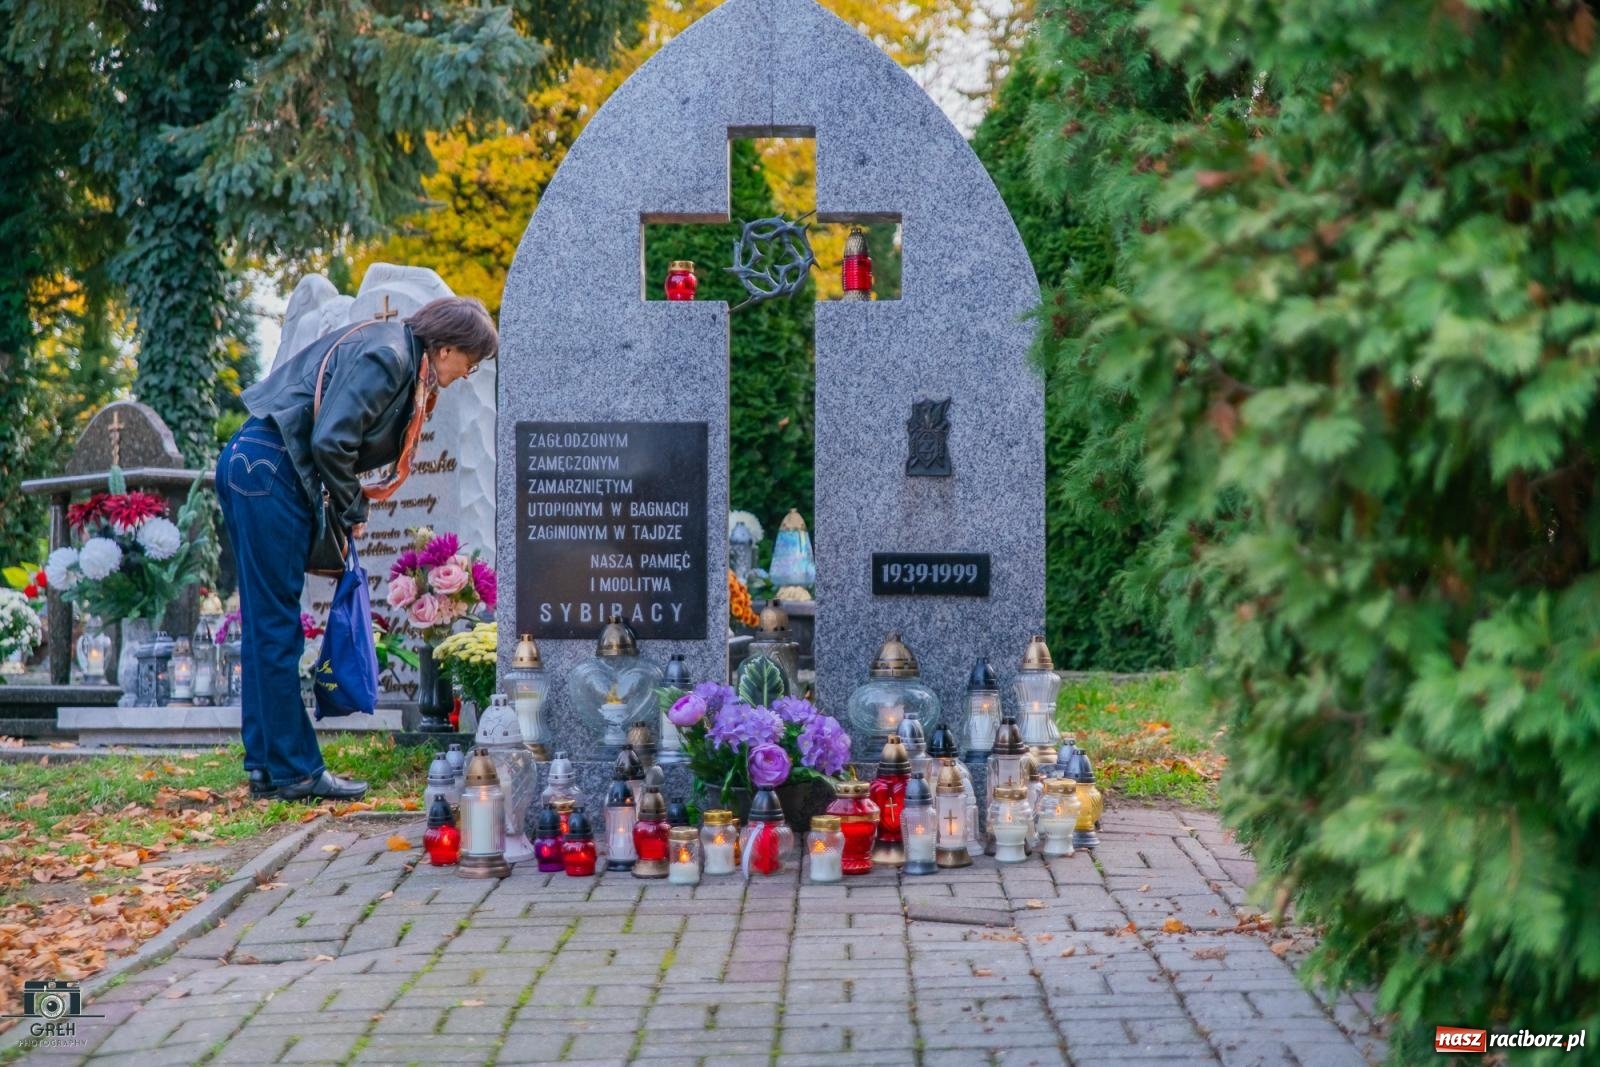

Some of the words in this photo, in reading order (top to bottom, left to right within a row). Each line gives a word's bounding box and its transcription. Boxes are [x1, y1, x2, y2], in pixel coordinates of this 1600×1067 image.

[528, 432, 628, 448] ZAGŁODZONYM
[528, 455, 620, 473] ZAMĘCZONYM
[528, 479, 633, 496] ZAMARZNIĘTYM
[528, 502, 603, 517] UTOPIONYM
[611, 502, 622, 516] W
[630, 502, 689, 517] BAGNACH
[528, 525, 608, 540] ZAGINIONYM
[613, 525, 625, 540] W
[632, 525, 683, 540] TAJDZE
[590, 554, 633, 569] NASZA
[641, 551, 691, 571] PAMIĘĆ
[882, 563, 978, 583] 1939-1999
[590, 577, 595, 592] I
[600, 577, 671, 592] MODLITWA
